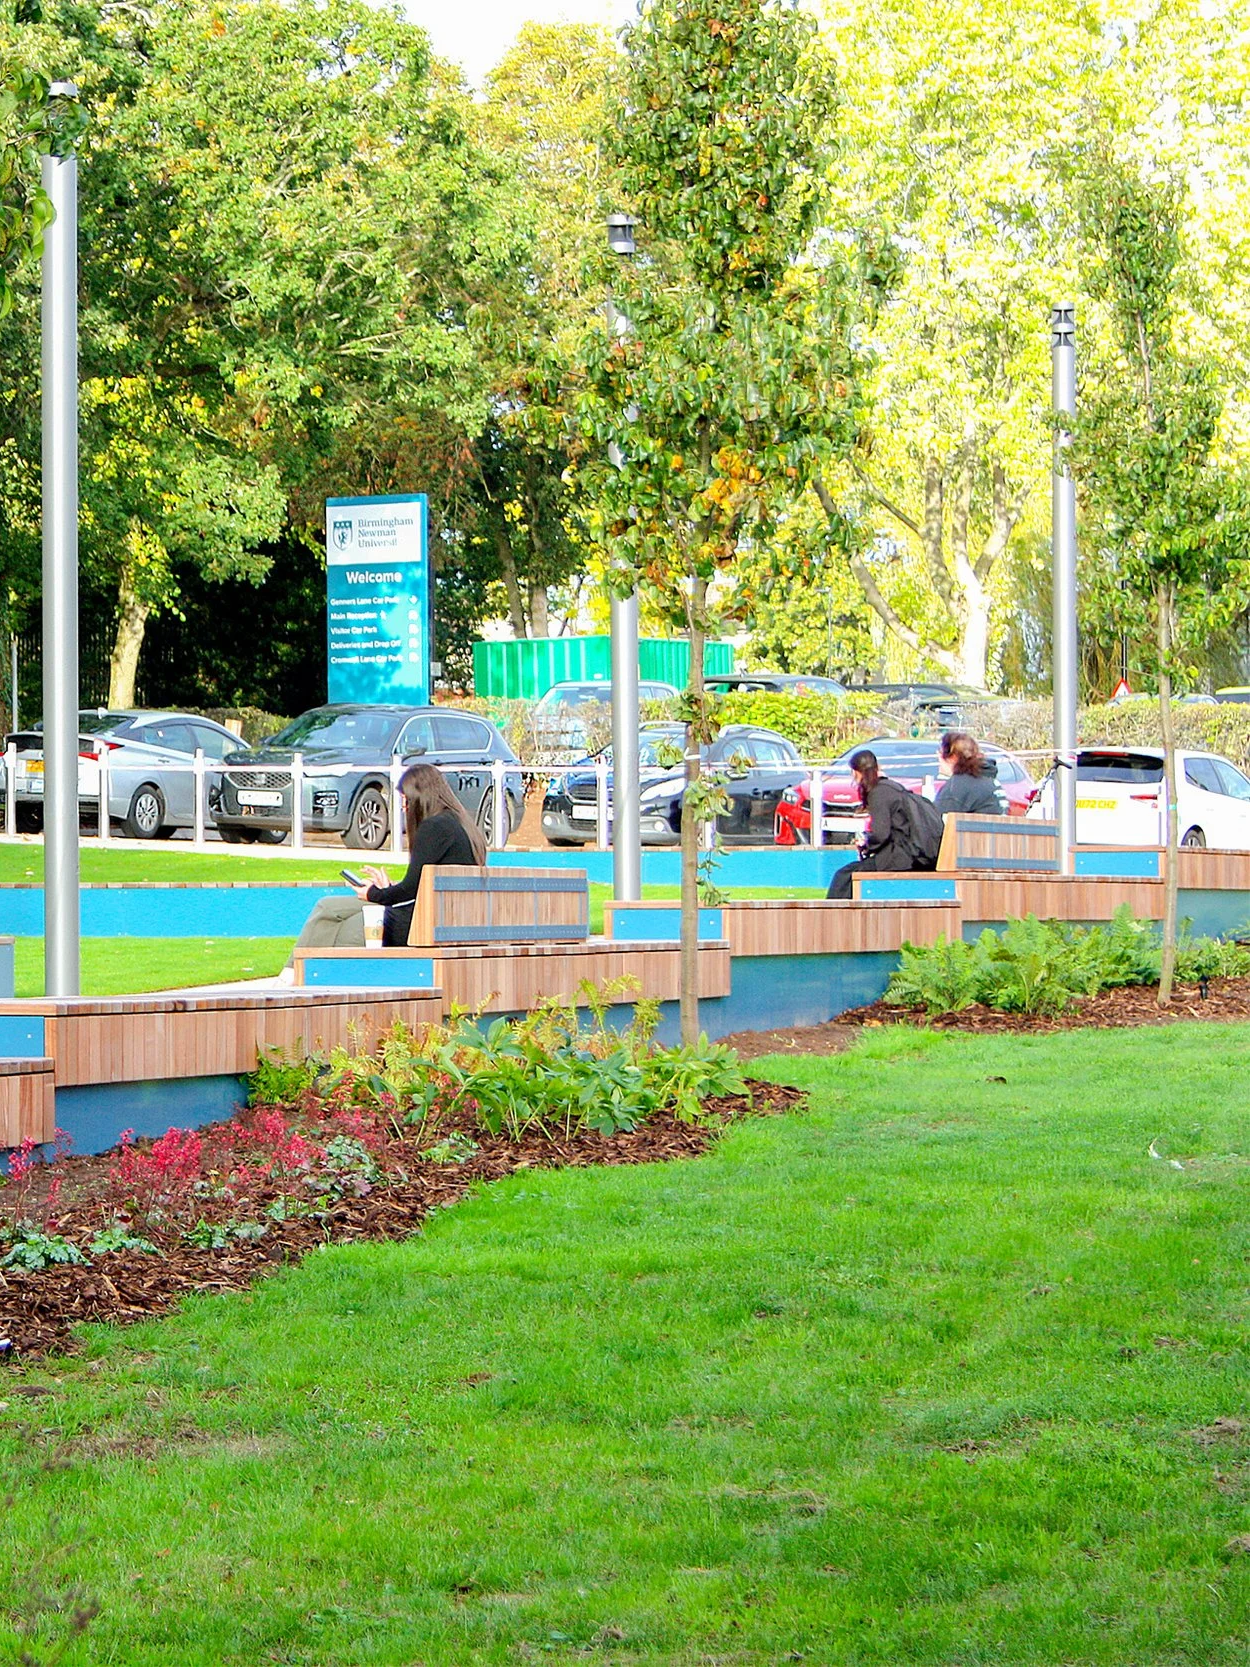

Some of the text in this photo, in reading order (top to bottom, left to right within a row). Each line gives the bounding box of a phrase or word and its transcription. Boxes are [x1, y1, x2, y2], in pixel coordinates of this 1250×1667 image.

[358, 516, 414, 529] Birmingham
[358, 529, 397, 538] Newman
[346, 571, 403, 585] Welcome
